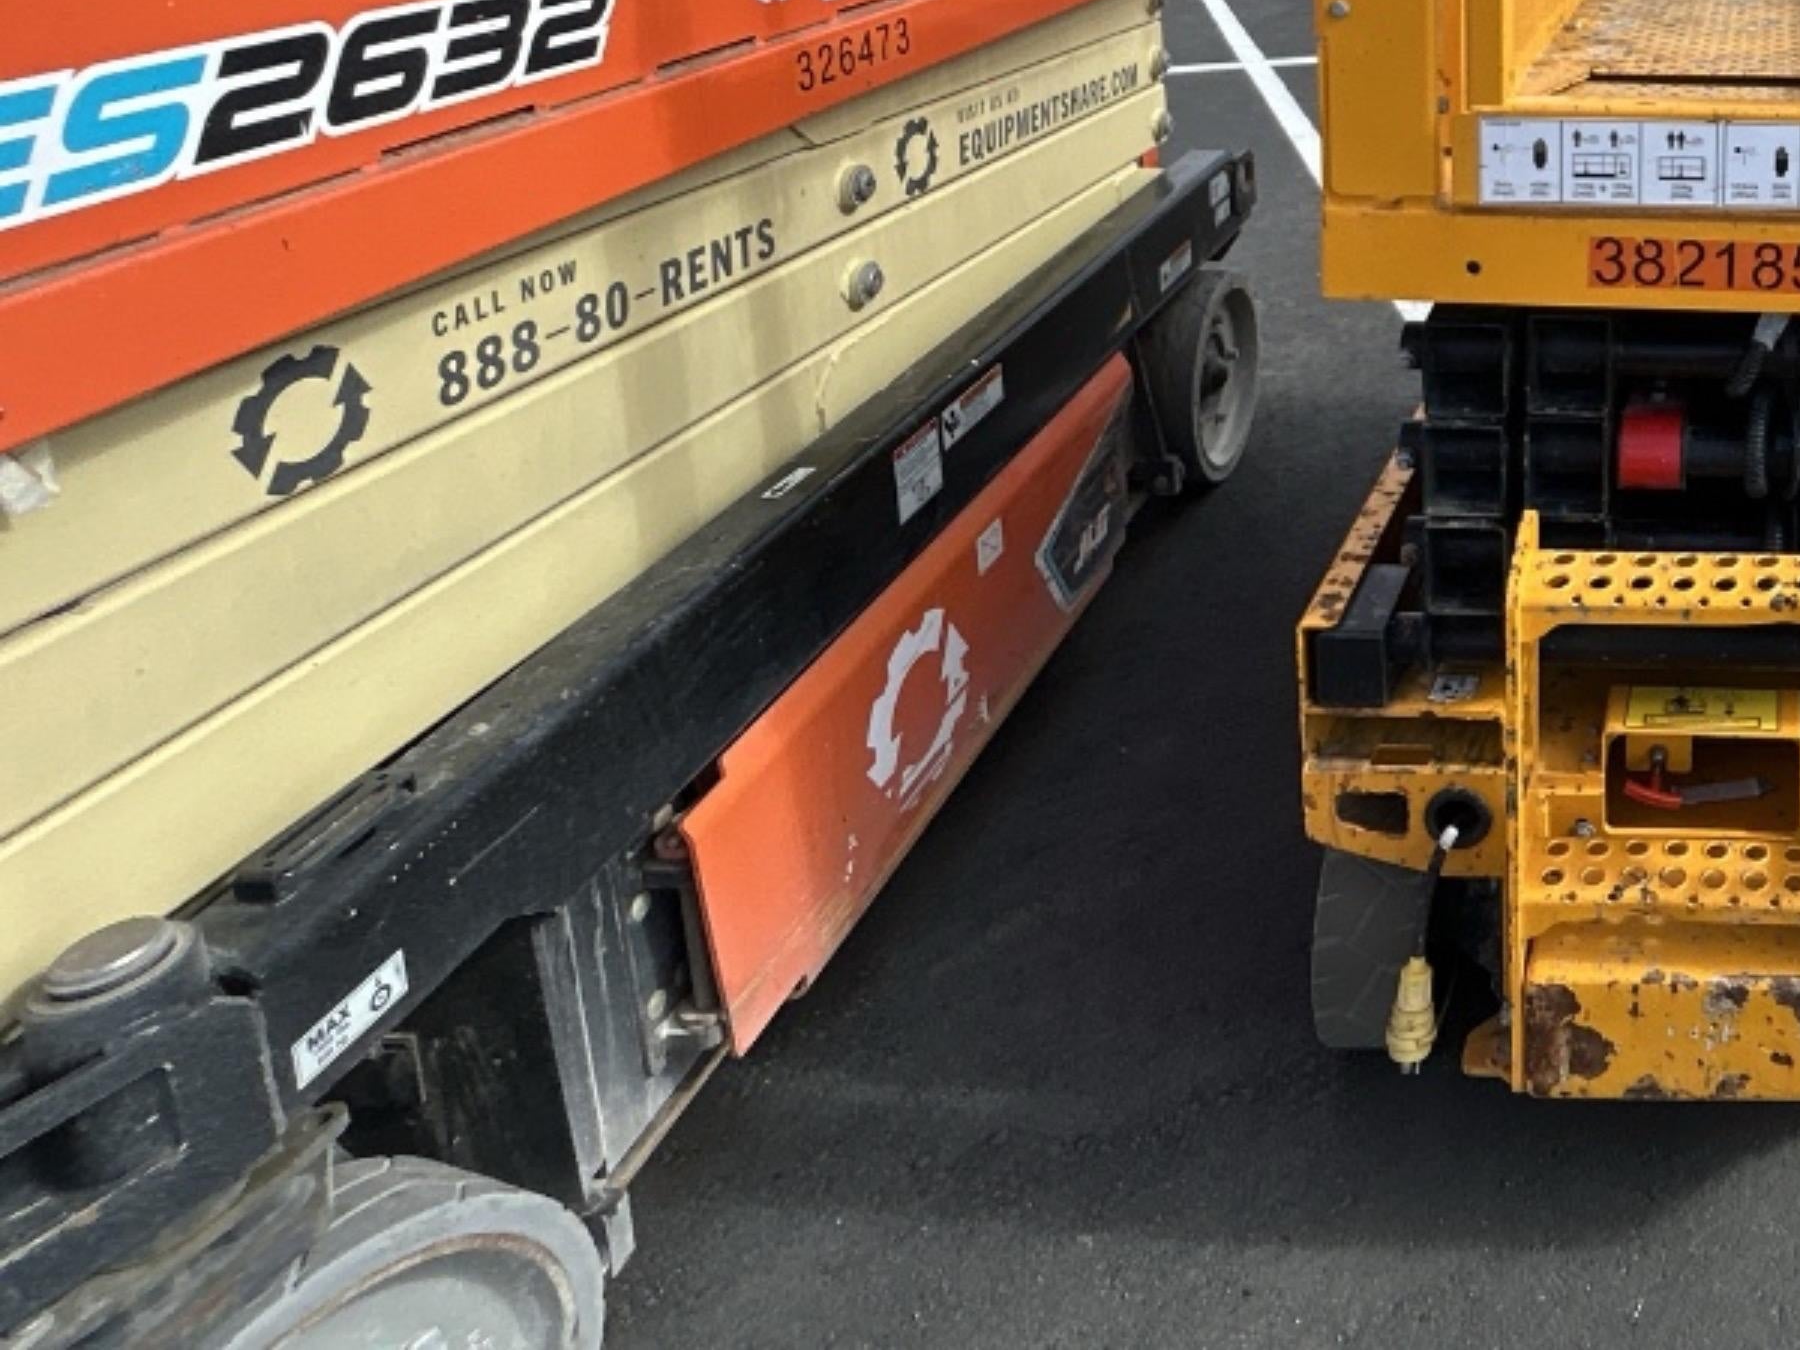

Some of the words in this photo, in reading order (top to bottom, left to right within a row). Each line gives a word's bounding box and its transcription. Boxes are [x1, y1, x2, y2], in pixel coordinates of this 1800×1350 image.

[796, 17, 911, 91] 326473
[958, 62, 1139, 166] EQUIPMENTSHARE.COM
[431, 290, 507, 337] CALL
[519, 260, 579, 303] NOW
[437, 217, 777, 407] 888-80-RENTS
